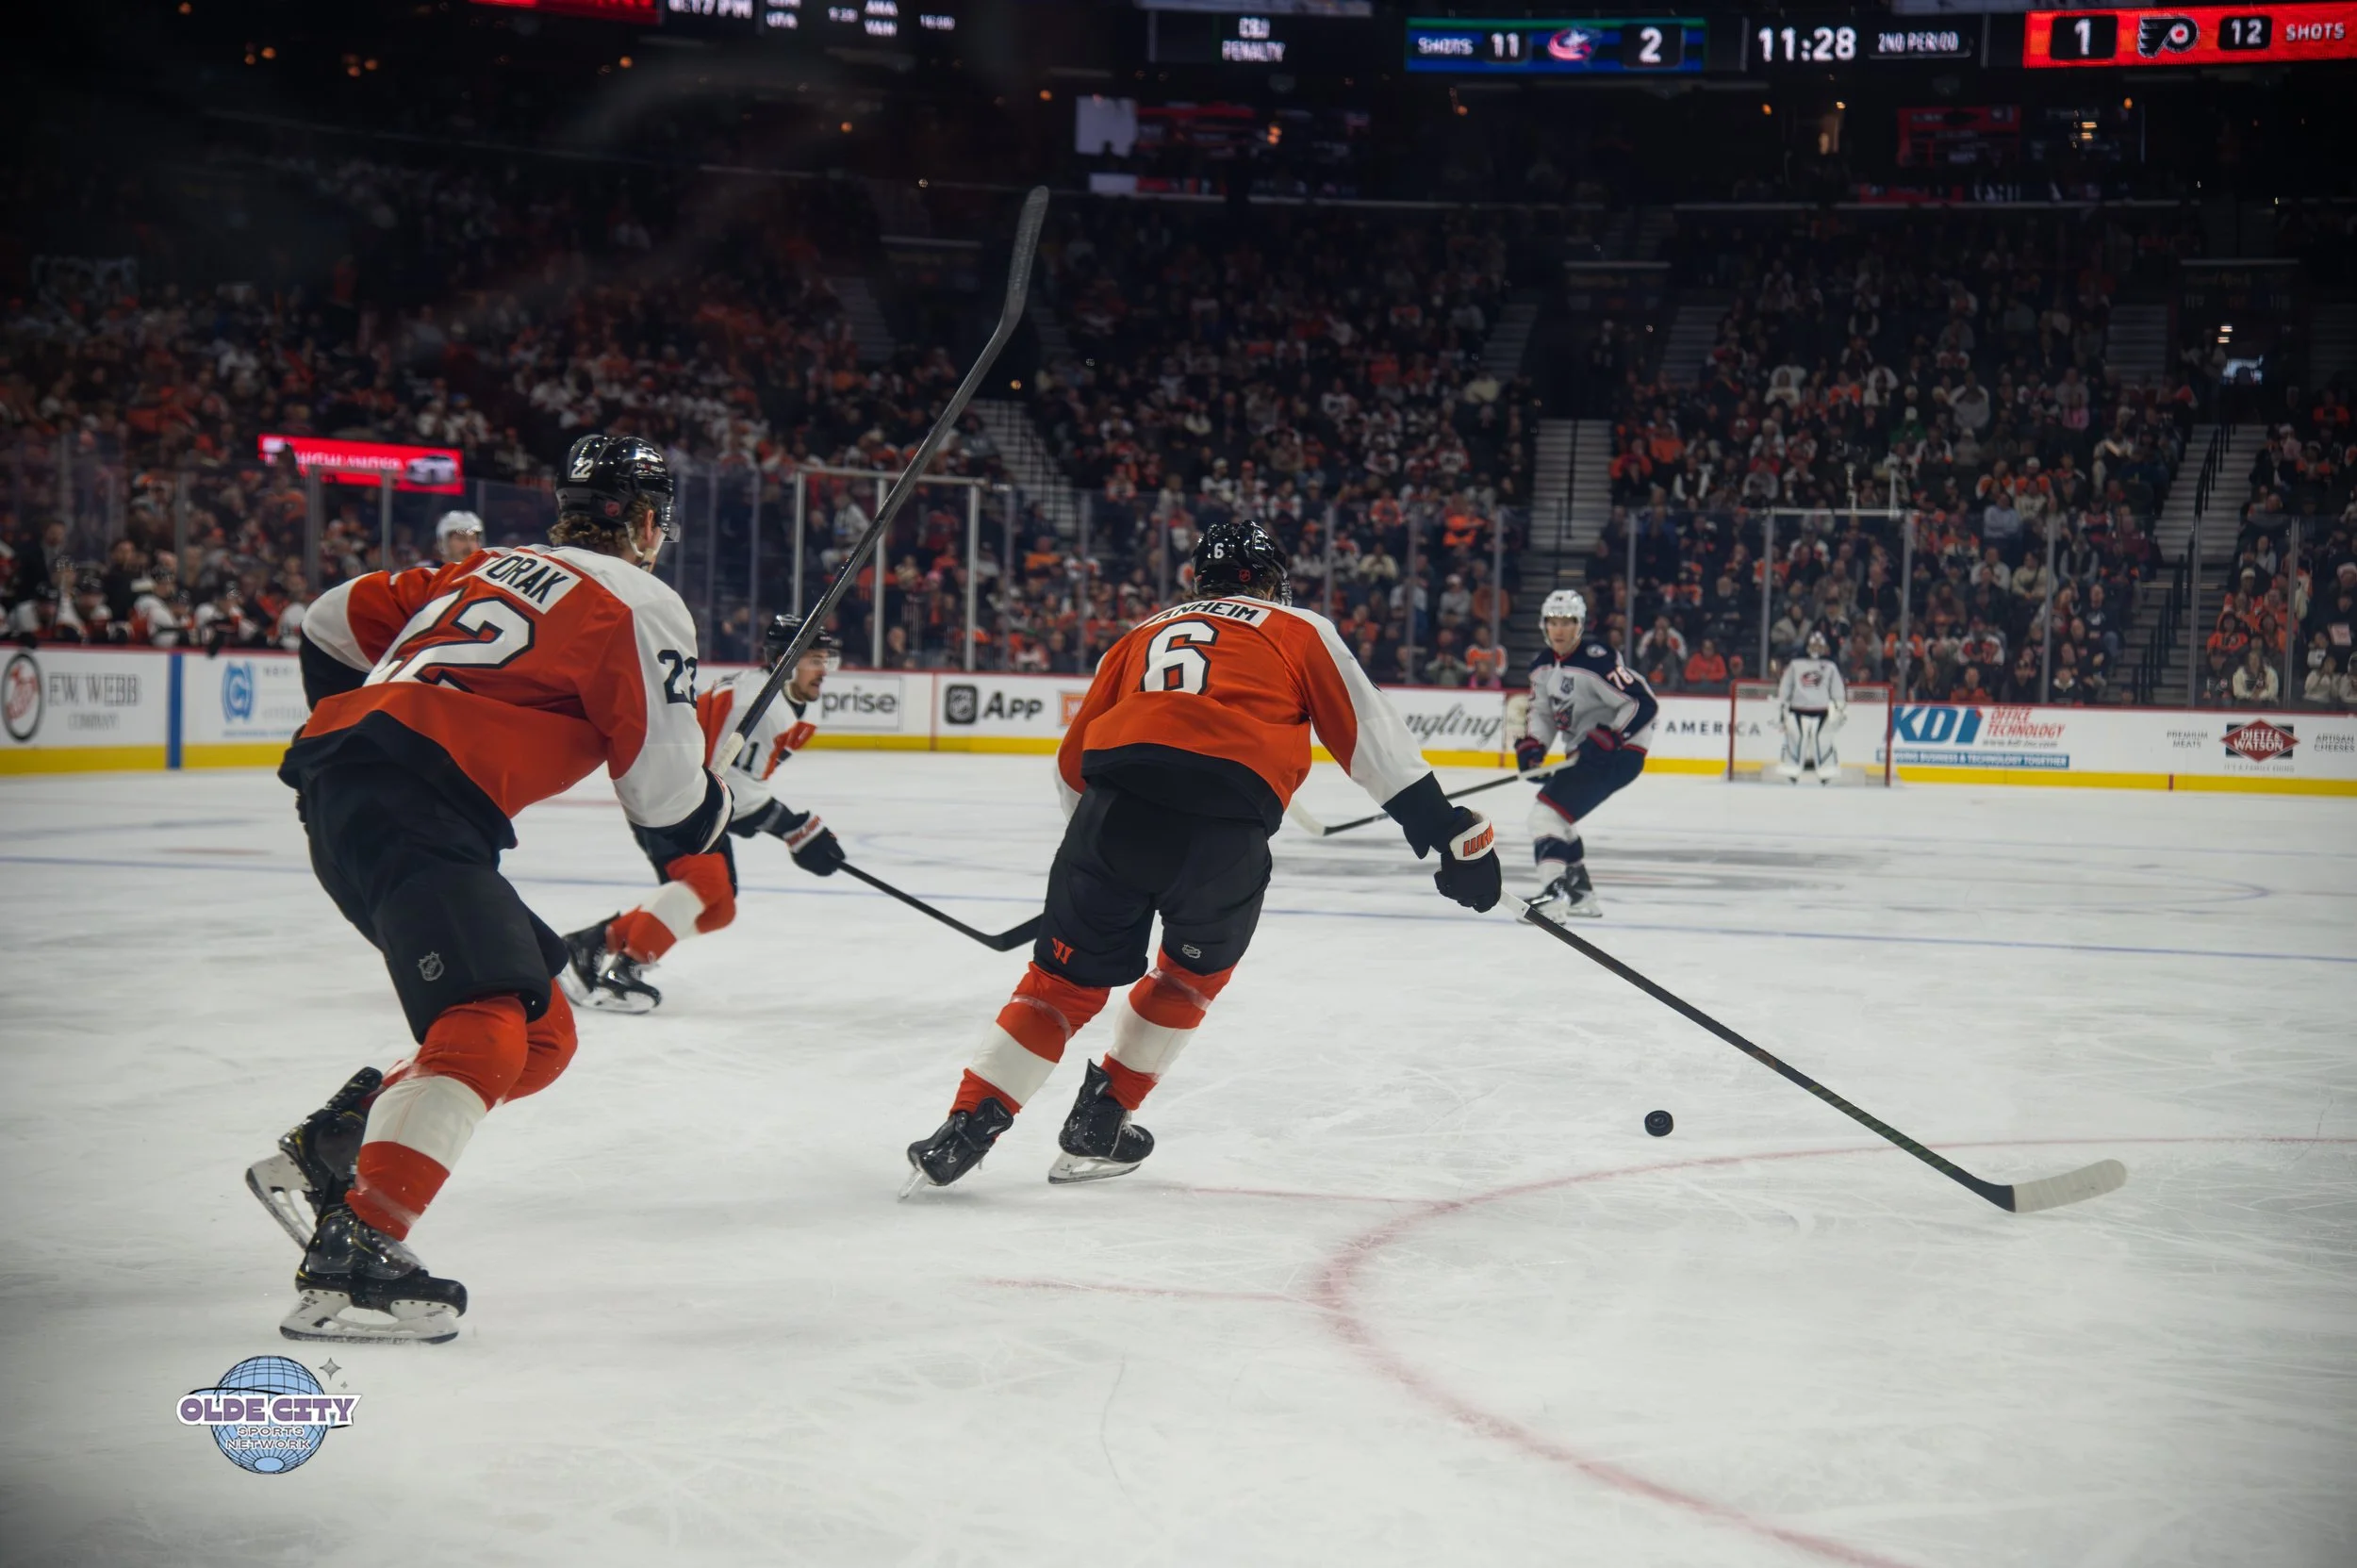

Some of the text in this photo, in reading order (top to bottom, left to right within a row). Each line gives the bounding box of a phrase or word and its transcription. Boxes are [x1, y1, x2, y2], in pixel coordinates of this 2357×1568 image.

[1418, 32, 1520, 58] SHOTS 11
[1639, 26, 1662, 63] 2
[1758, 26, 1857, 62] 11:28
[1878, 31, 1959, 53] 2ND PERIOD
[2074, 19, 2091, 56] 1
[2231, 19, 2346, 45] 12 SHOTS
[1222, 41, 1285, 62] PENALTY
[568, 456, 594, 482] 22
[1213, 542, 1225, 559] 6
[476, 553, 569, 604] ORAK
[1157, 601, 1260, 622] ANHEIM
[1140, 619, 1220, 696] 6
[85, 672, 142, 707] WEBB
[820, 685, 898, 720] prise
[982, 690, 1044, 721] App
[1990, 706, 2034, 723] OFFICE
[1405, 701, 1504, 748] ngling
[1986, 722, 2066, 738] TECHNOLOGY
[2167, 730, 2208, 740] PREMIUM
[2172, 740, 2201, 749] MEATS
[2233, 738, 2283, 752] WATSON
[2314, 743, 2355, 753] CHEESES
[2316, 733, 2354, 744] ARTISAN
